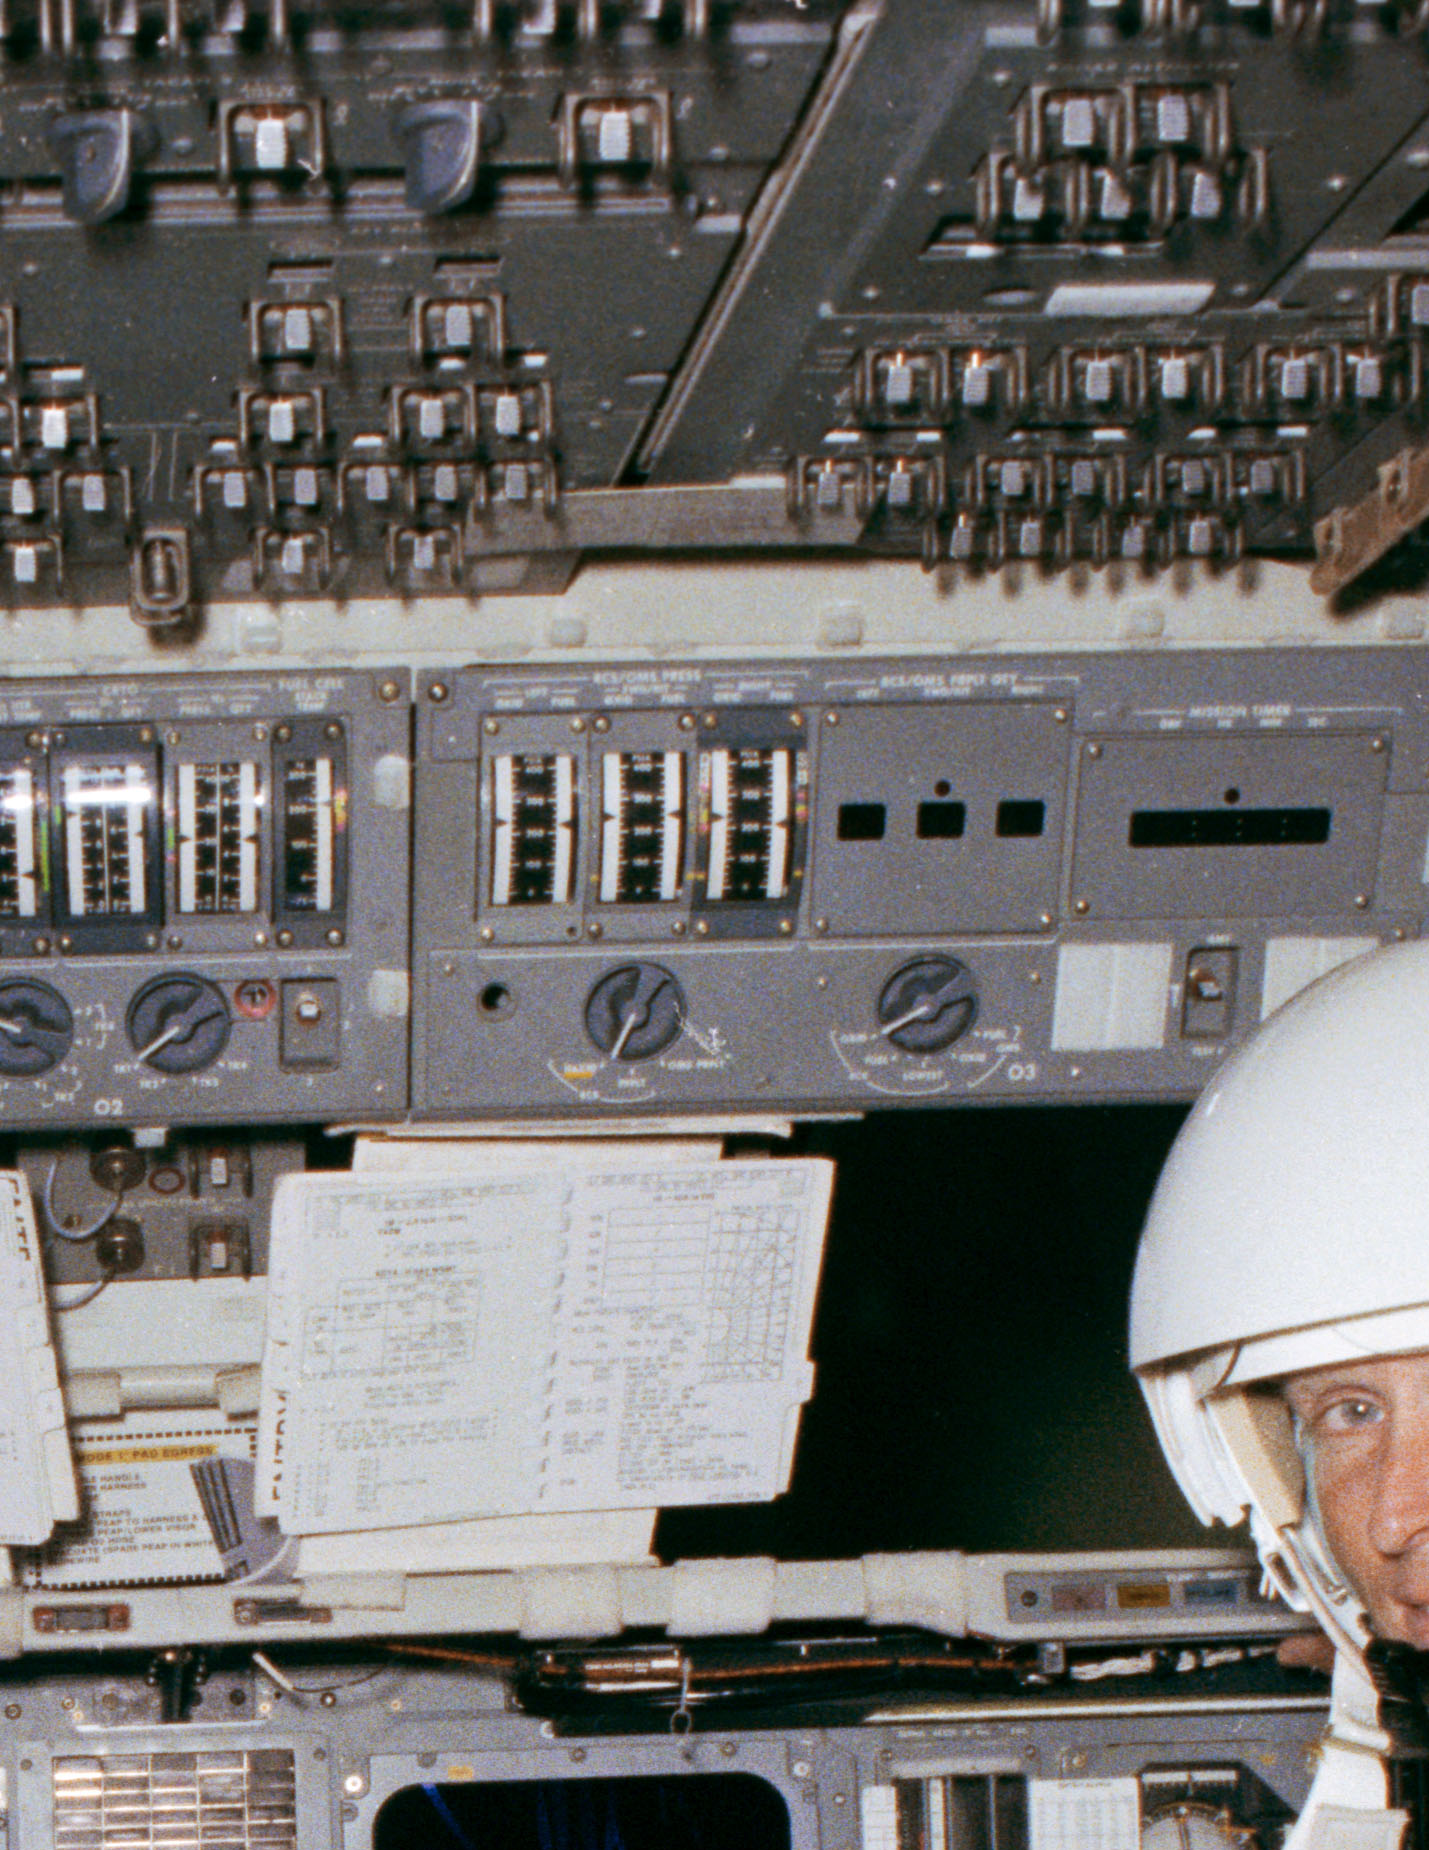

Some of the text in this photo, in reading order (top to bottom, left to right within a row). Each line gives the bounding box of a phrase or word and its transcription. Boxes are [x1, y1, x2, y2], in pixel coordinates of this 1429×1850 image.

[594, 670, 700, 684] RCS/OMS PRESS
[881, 674, 943, 687] RCS/OMS
[278, 679, 309, 690] FUEL
[1190, 705, 1290, 716] MISSION TIMER
[94, 1099, 123, 1115] O2
[133, 1450, 159, 1460] PAD
[163, 1446, 213, 1458] EGRESS
[100, 1473, 140, 1482] HANDLE
[100, 1482, 147, 1491] HARNESS
[95, 1510, 131, 1519] STRAPS
[143, 1515, 188, 1524] HARNESS
[166, 1524, 195, 1532] VISOR
